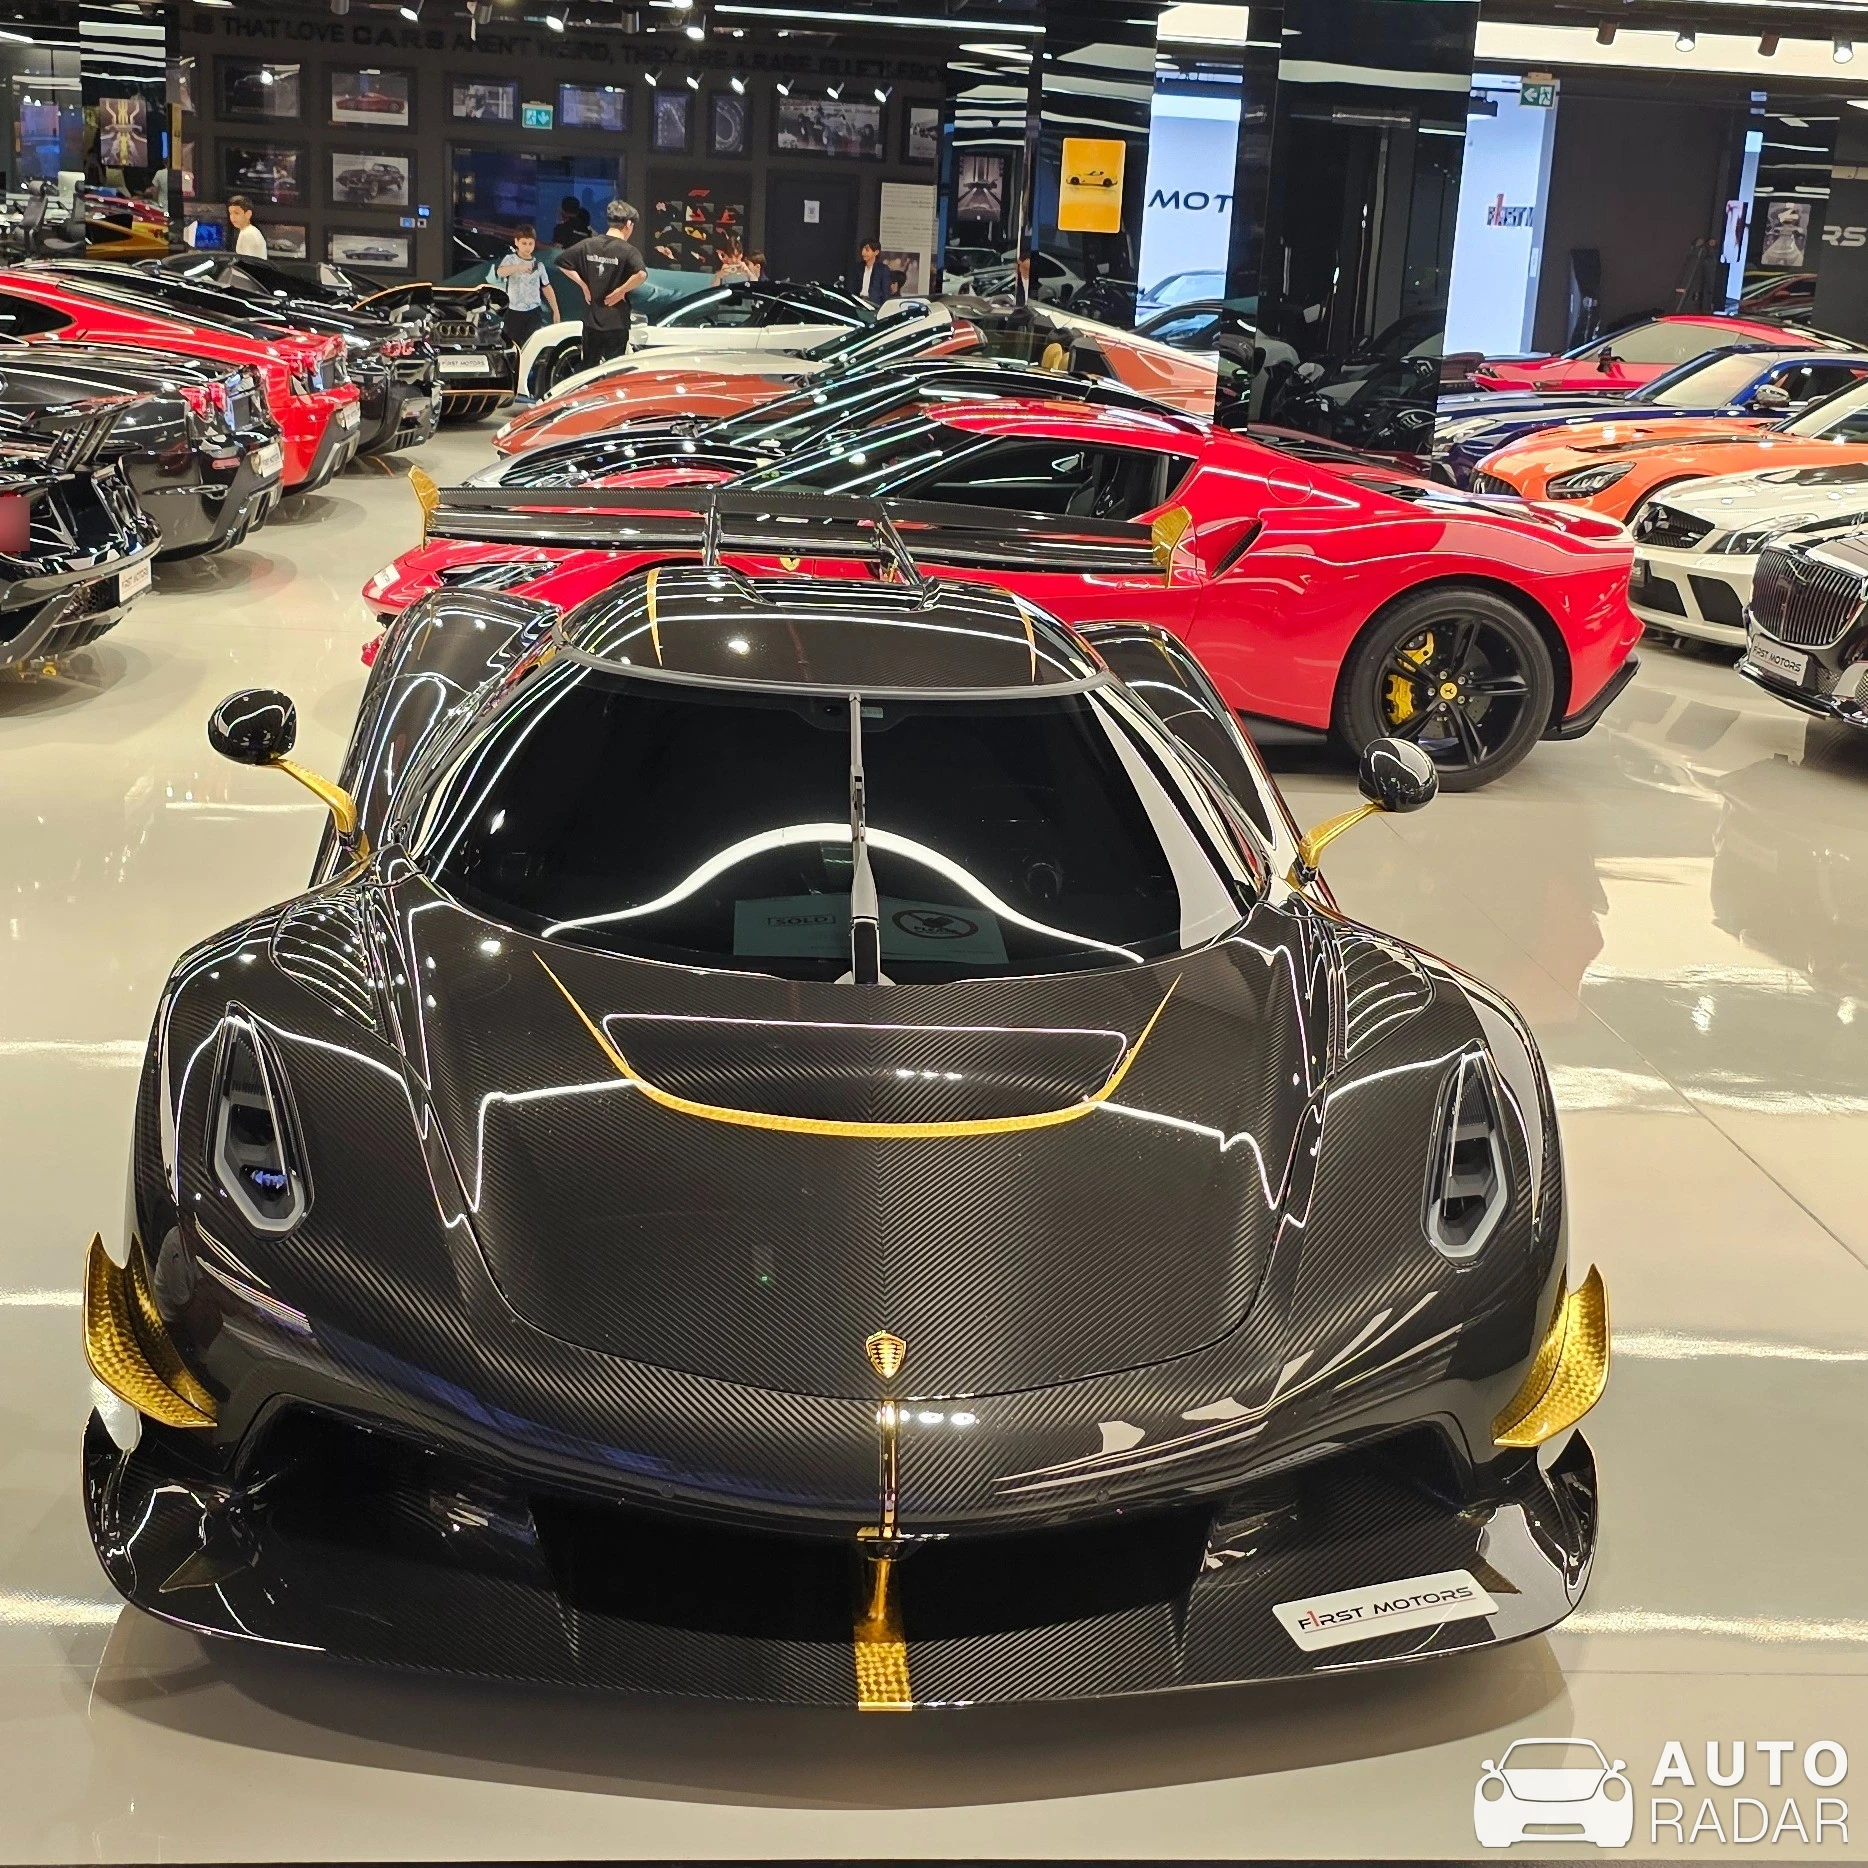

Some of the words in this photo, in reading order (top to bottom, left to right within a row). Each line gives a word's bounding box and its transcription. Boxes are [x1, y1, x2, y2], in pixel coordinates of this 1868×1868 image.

[221, 16, 281, 39] THAT
[285, 20, 345, 43] LOVE
[353, 25, 445, 50] CARS
[1148, 189, 1235, 213] MOT
[1769, 653, 1801, 672] MOTORS
[774, 915, 829, 926] SOLD
[1373, 1586, 1474, 1615] MOTORS
